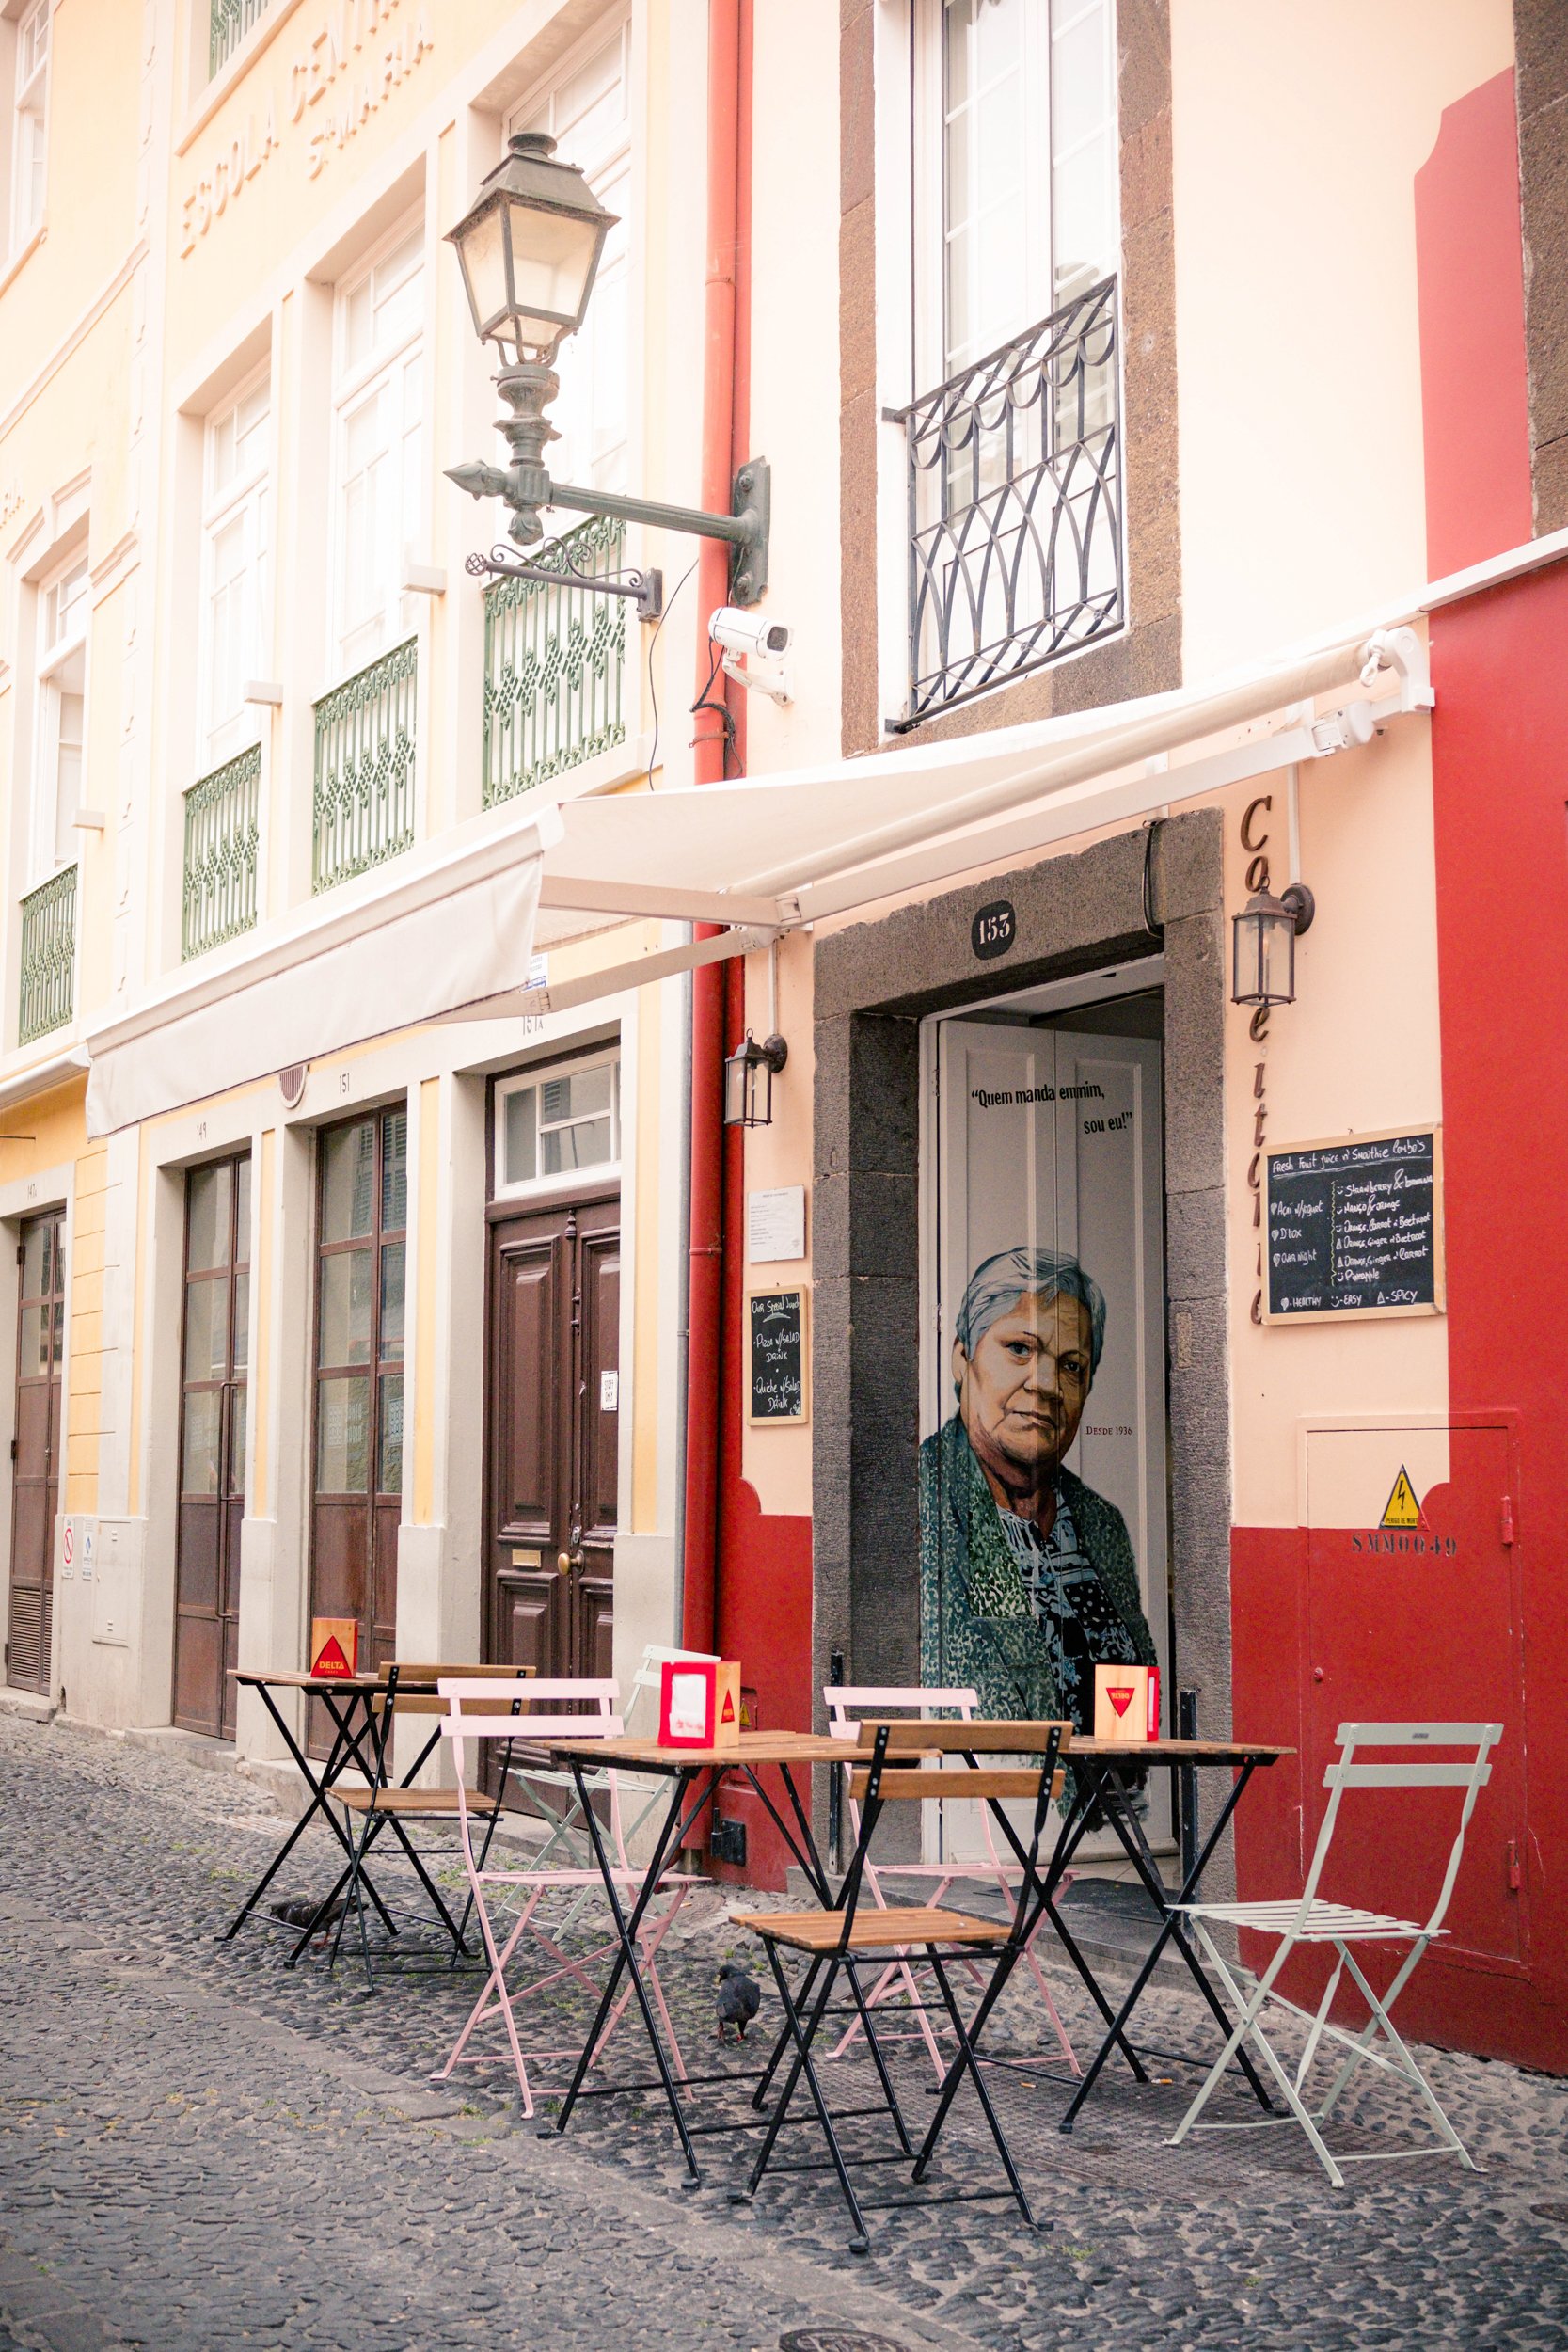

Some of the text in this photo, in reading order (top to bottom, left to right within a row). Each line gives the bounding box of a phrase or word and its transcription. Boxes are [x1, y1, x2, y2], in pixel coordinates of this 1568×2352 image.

[979, 912, 1011, 945] 153
[339, 1073, 350, 1095] 151
[1015, 1084, 1055, 1104] manda
[197, 1121, 207, 1142] 149
[1084, 1119, 1105, 1135] sou
[1352, 1146, 1390, 1160] Smoothie
[1344, 1267, 1380, 1283] Pineapple
[1115, 1425, 1132, 1436] 1936
[318, 1661, 345, 1670] DELTA
